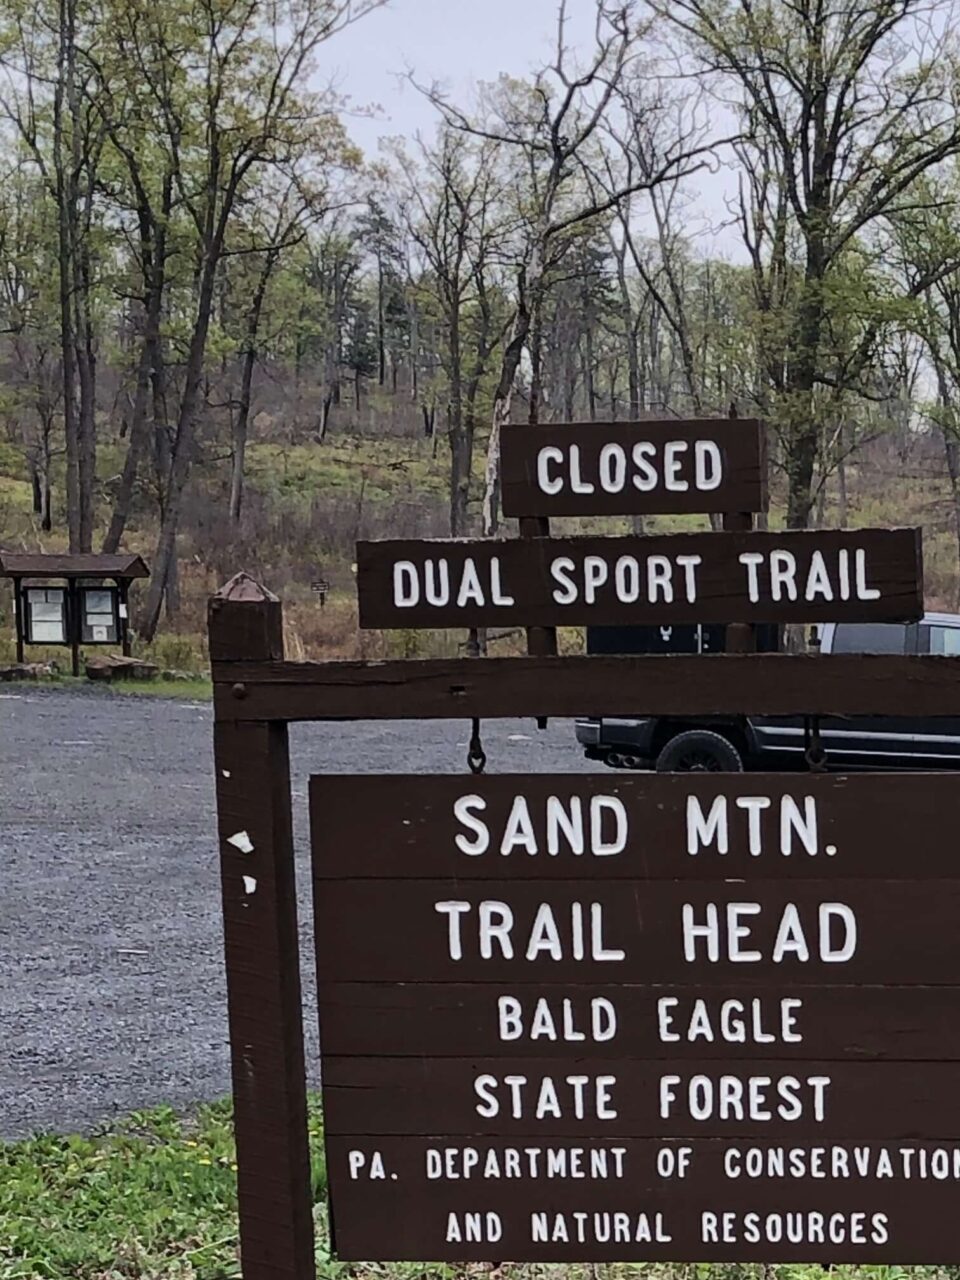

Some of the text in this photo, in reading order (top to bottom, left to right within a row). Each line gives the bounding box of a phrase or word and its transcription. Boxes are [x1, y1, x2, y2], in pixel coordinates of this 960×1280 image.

[537, 440, 723, 496] CLOSED
[393, 547, 881, 609] DUAL SPORT TRAIL
[453, 794, 838, 857] SAND MTN.
[434, 900, 858, 963] TRAIL HEAD
[498, 995, 804, 1043] BALD EAGLE
[474, 1074, 832, 1122] STATE FOREST
[348, 1149, 399, 1180] PA.
[426, 1147, 627, 1179] DEPARTMENT
[657, 1147, 693, 1179] OF
[445, 1211, 889, 1244] AND NATURAL RESOURCES
